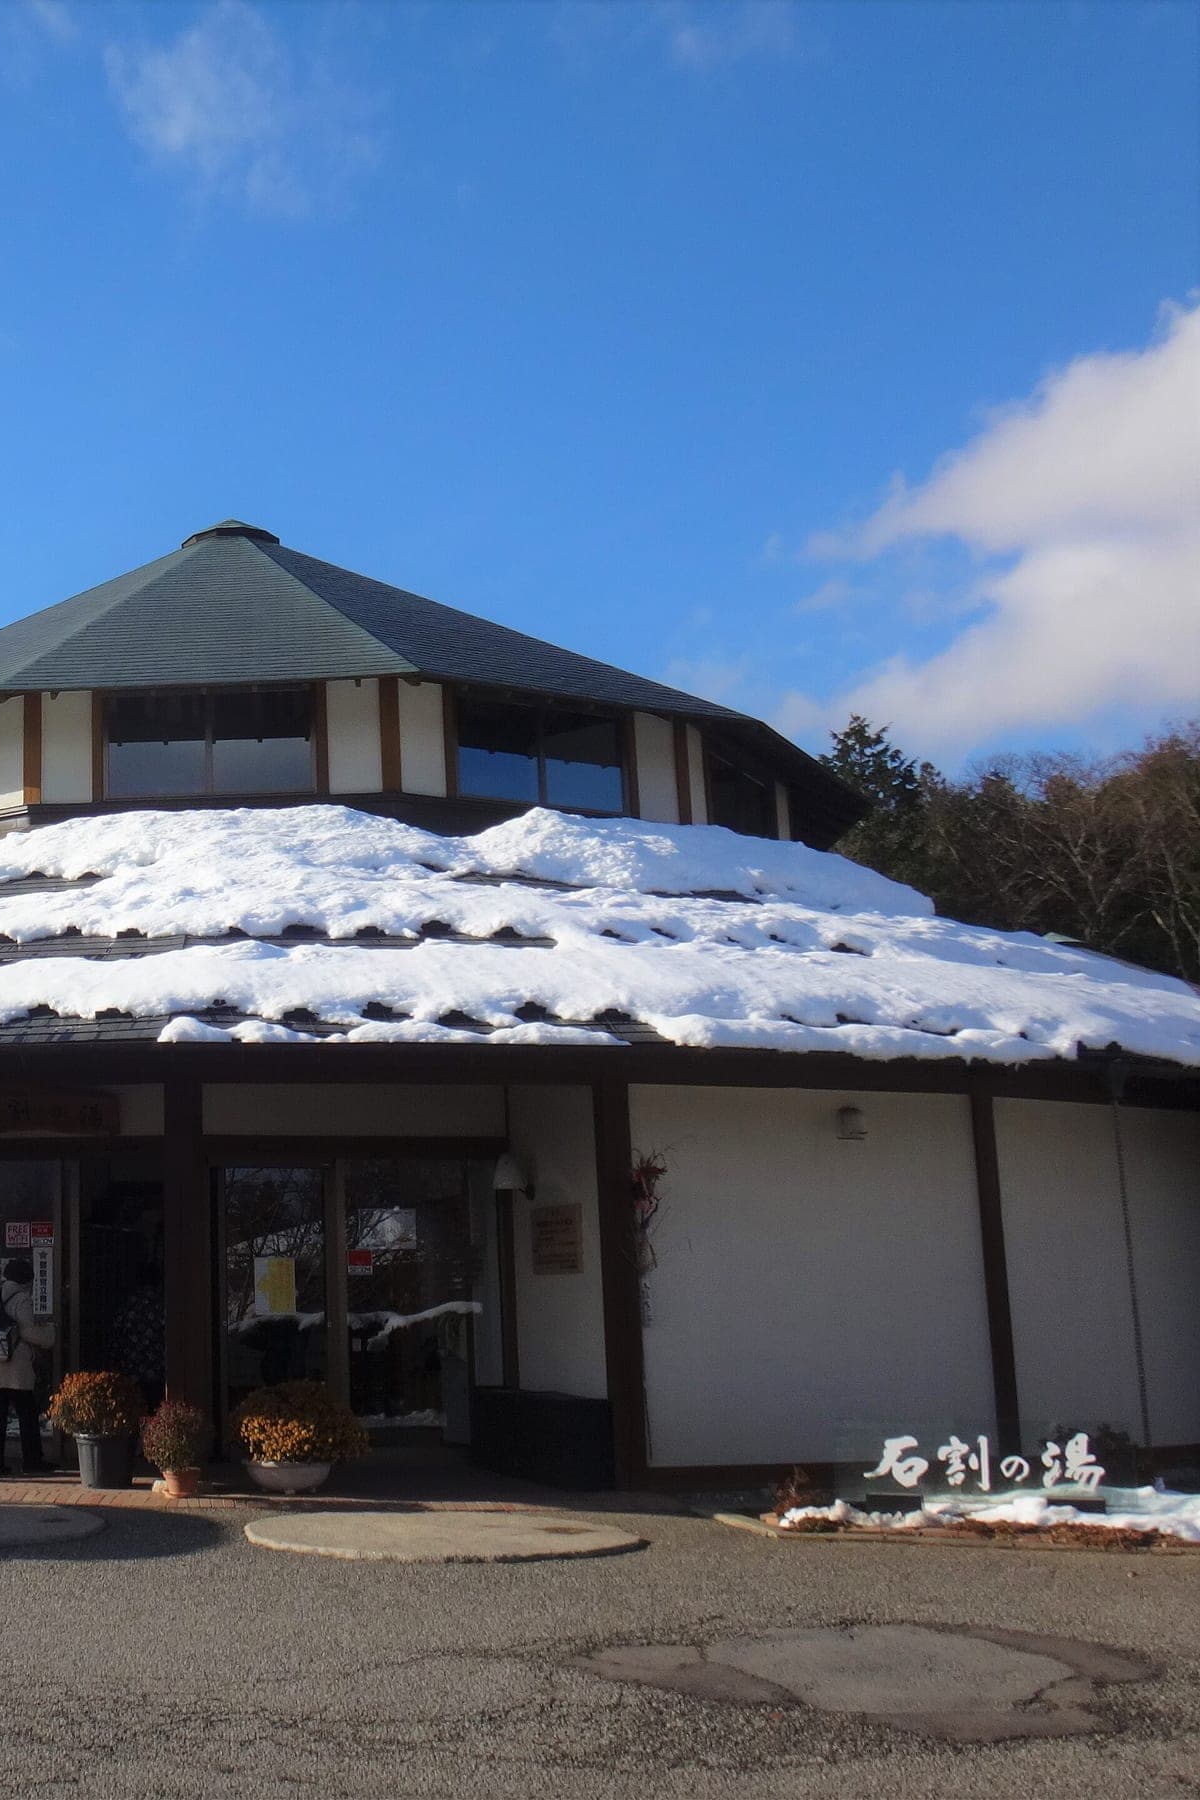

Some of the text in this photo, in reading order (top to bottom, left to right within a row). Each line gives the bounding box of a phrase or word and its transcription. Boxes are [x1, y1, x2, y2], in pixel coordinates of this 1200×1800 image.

[7, 1224, 28, 1233] FREE
[863, 1432, 1106, 1492] 石割の湯
